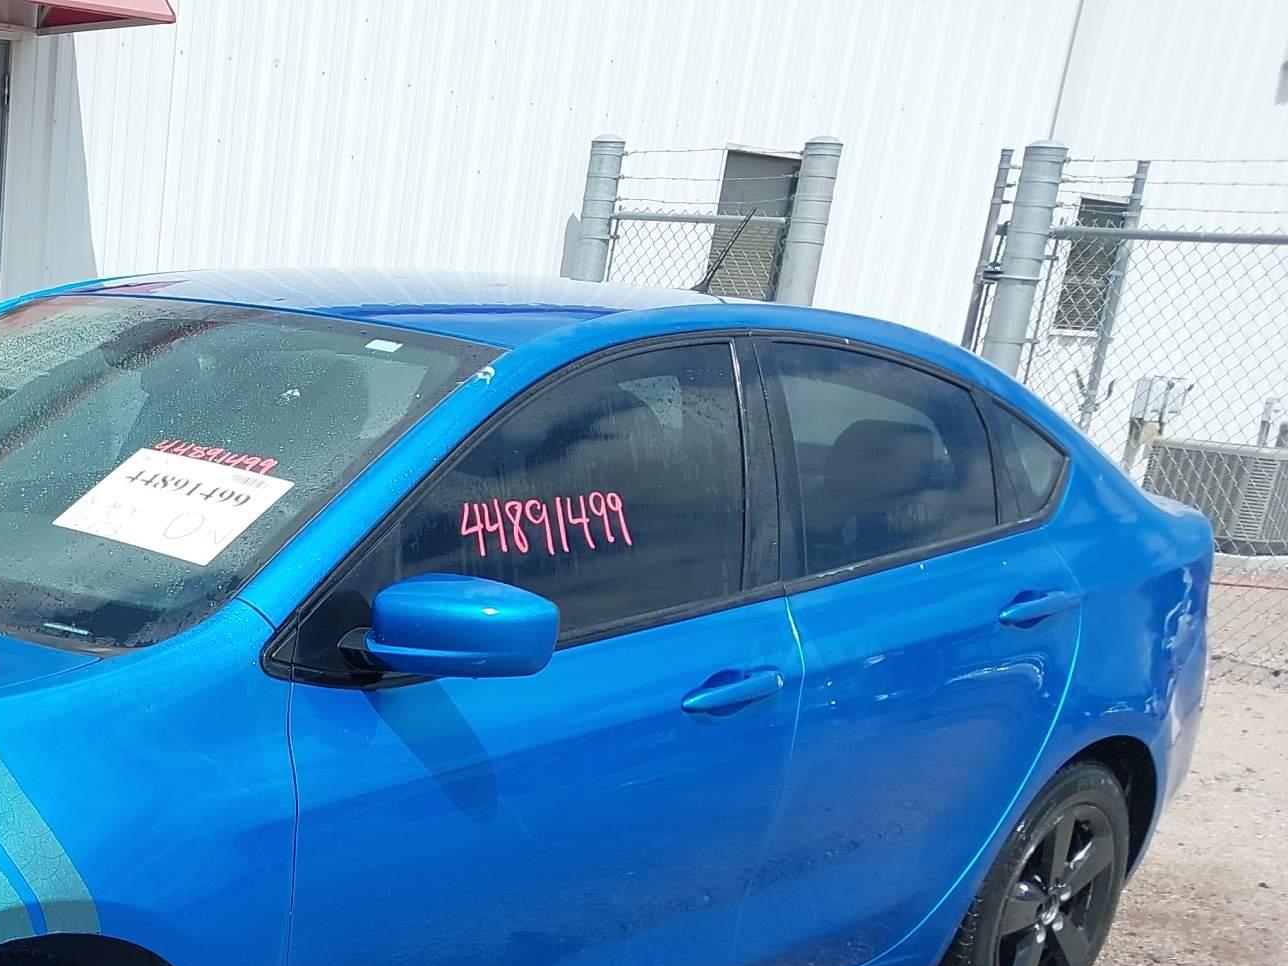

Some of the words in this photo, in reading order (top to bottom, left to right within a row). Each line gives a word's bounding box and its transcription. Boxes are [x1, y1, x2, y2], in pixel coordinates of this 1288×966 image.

[155, 440, 279, 475] 44891499
[125, 469, 252, 507] 44891499
[462, 491, 633, 557] 44891499
